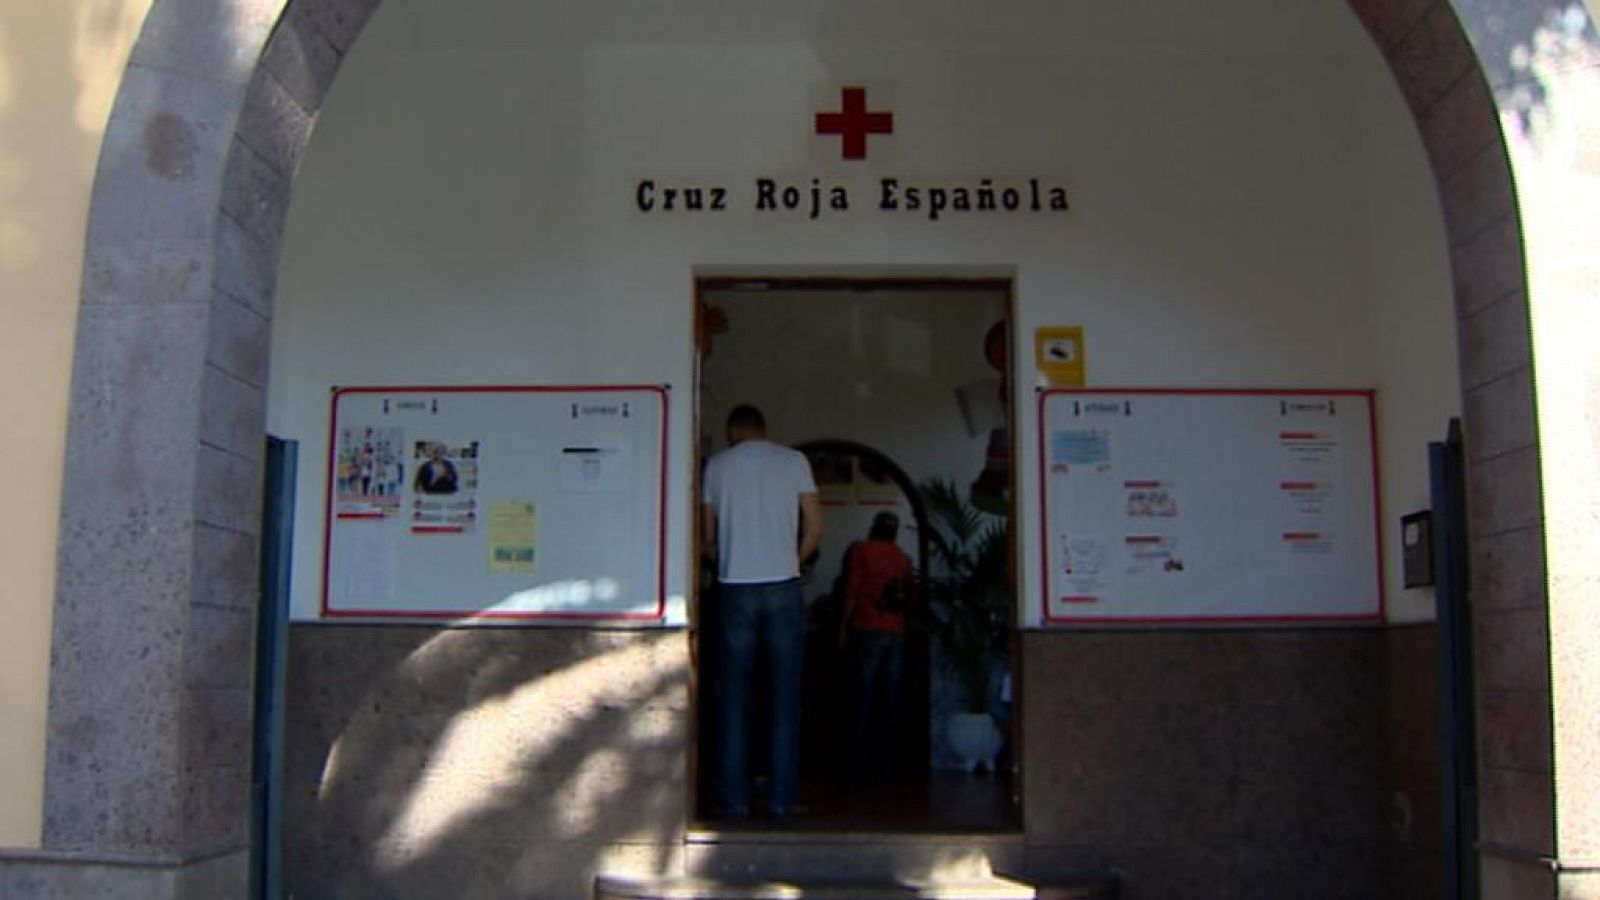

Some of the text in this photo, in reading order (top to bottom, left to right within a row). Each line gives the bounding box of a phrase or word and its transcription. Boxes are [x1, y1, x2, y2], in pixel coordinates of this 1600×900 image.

[636, 178, 1070, 220] Cruz Roja Española
